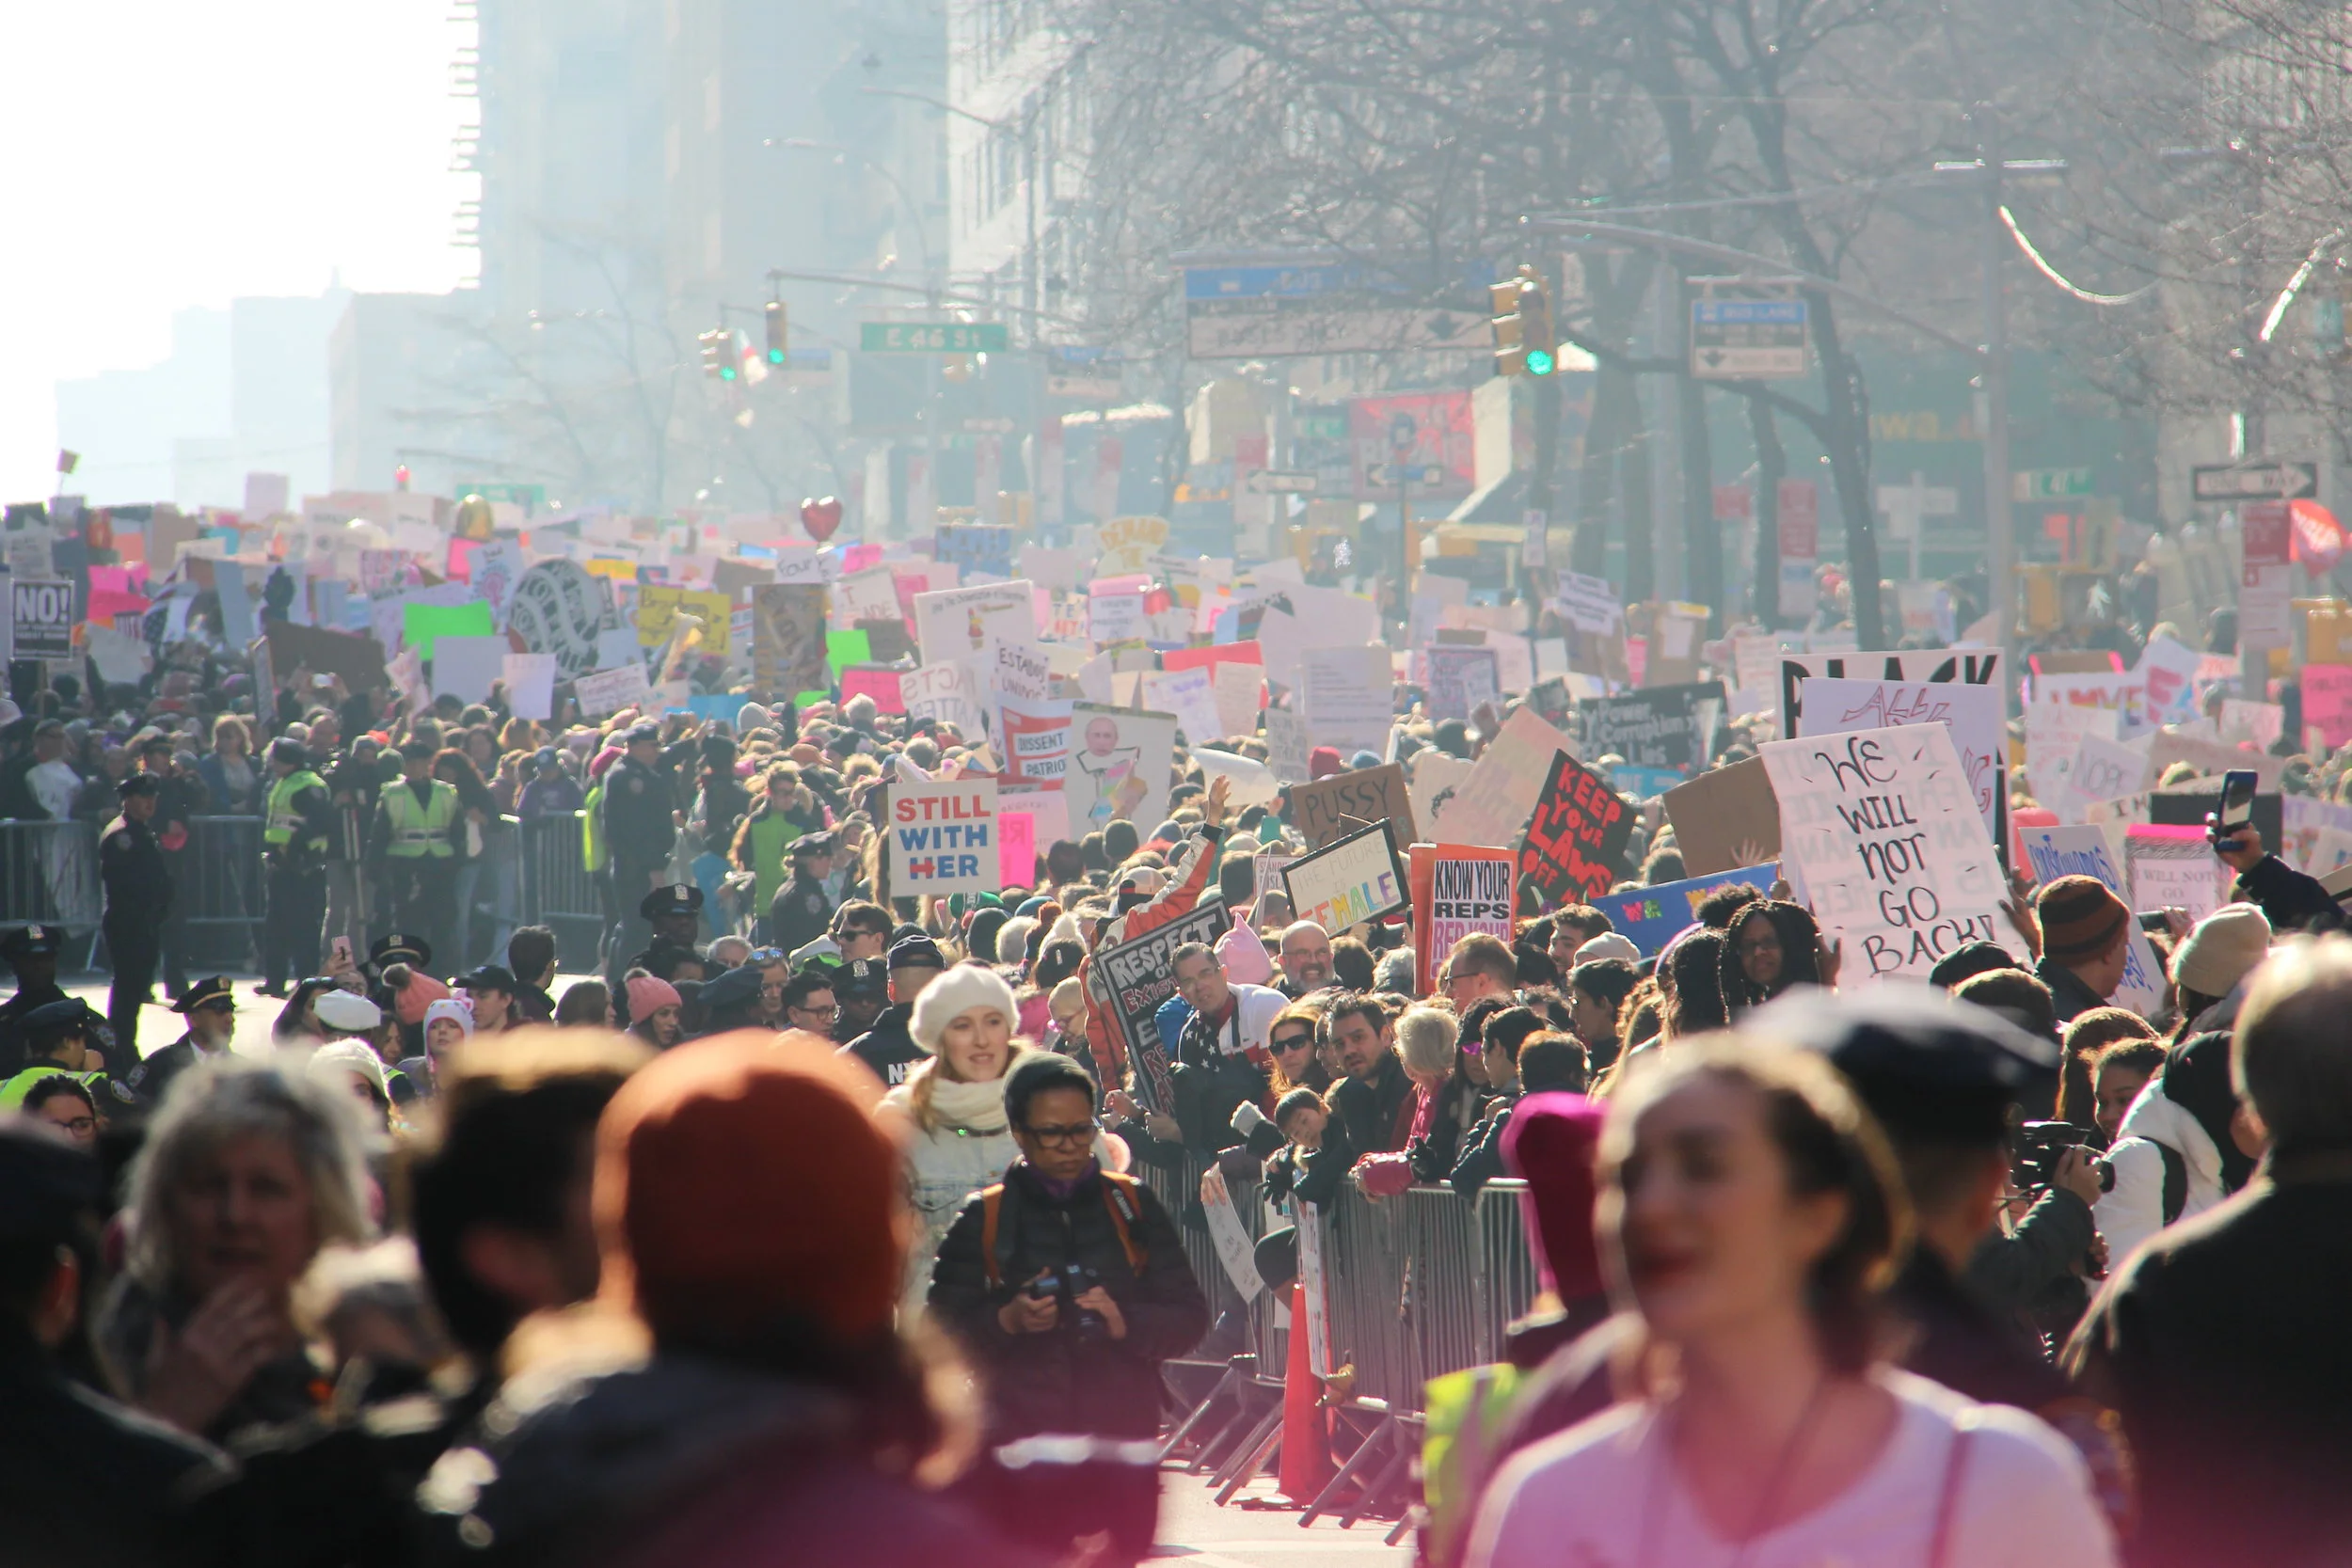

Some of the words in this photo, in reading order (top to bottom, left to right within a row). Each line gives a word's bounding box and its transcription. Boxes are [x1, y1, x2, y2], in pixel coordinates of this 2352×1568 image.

[886, 329, 900, 348] E
[15, 585, 70, 624] NO!
[1597, 700, 1652, 723] Power
[1017, 732, 1064, 752] DISSENT
[1025, 758, 1066, 777] PATRIO
[1815, 736, 1898, 792] WE
[895, 794, 992, 823] STILL
[1304, 775, 1390, 829] PUSSY
[1557, 762, 1622, 828] KEEP
[1836, 793, 1918, 835] WILL
[898, 823, 989, 852] WITH
[1550, 792, 1604, 849] YOUR
[909, 854, 980, 880] HER
[1327, 834, 1386, 876] FUTURE
[1521, 849, 1560, 889] OFF
[1527, 802, 1613, 899] LAWS
[1435, 861, 1473, 900] KNOW
[1474, 862, 1510, 901] YOUR
[2143, 868, 2177, 883] WILL
[2182, 868, 2213, 883] NOT
[2161, 885, 2185, 899] GO
[1434, 902, 1509, 919] REPS
[1879, 886, 1941, 928] GO
[1107, 912, 1217, 990] RESPECT
